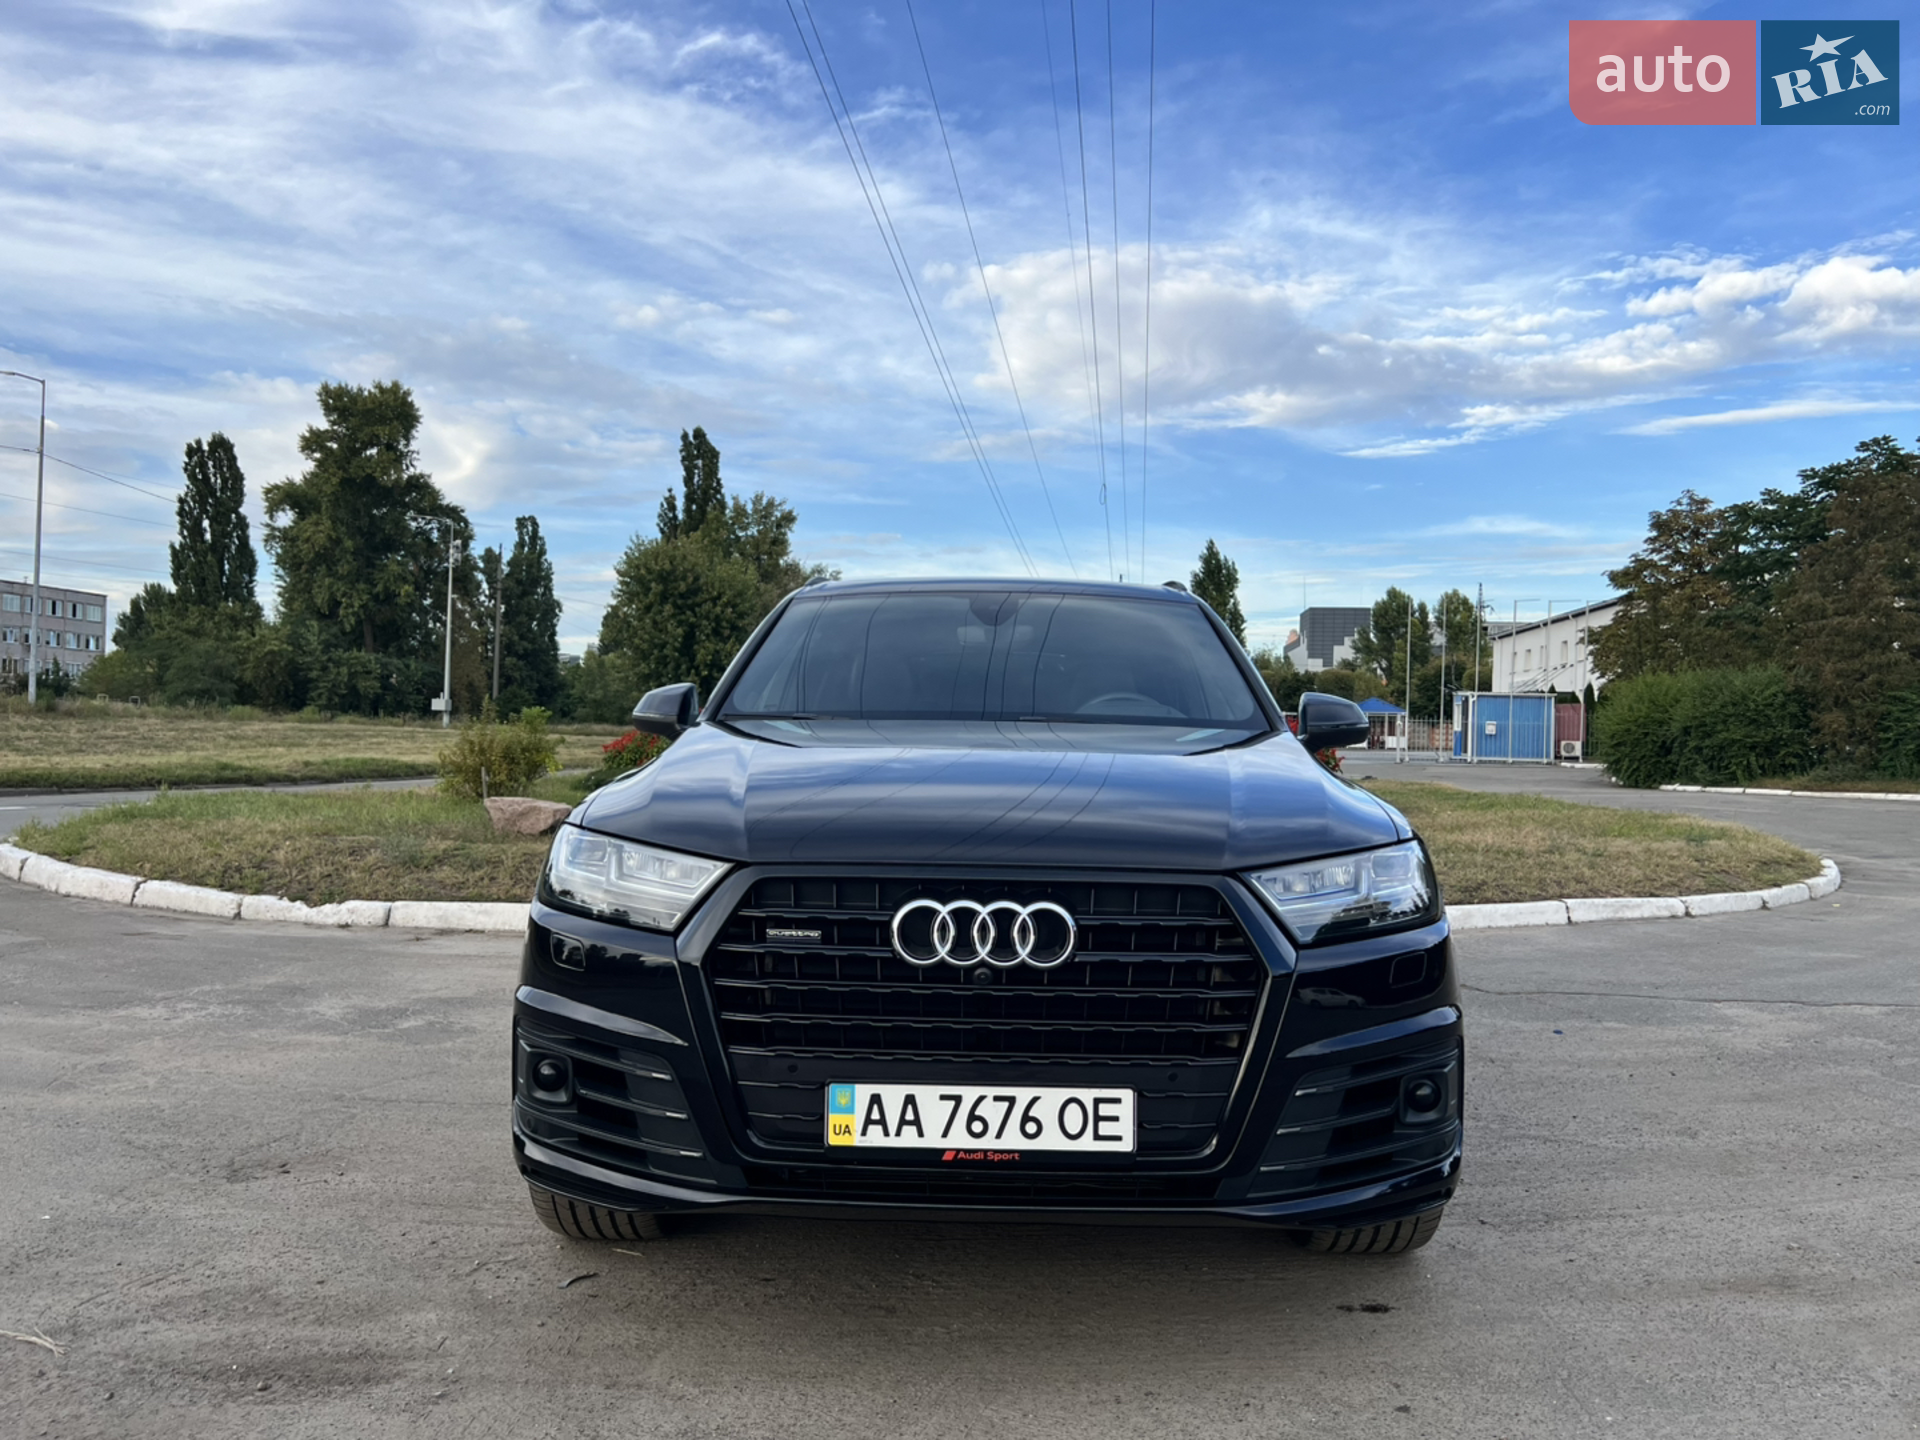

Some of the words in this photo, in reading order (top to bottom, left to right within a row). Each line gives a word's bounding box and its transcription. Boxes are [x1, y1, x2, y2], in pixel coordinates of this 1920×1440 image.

[860, 1093, 925, 1138] AA
[938, 1094, 1044, 1140] 7676
[1057, 1096, 1123, 1141] OE
[833, 1124, 852, 1137] UA
[957, 1151, 985, 1160] Audi
[986, 1151, 1020, 1162] Sport
